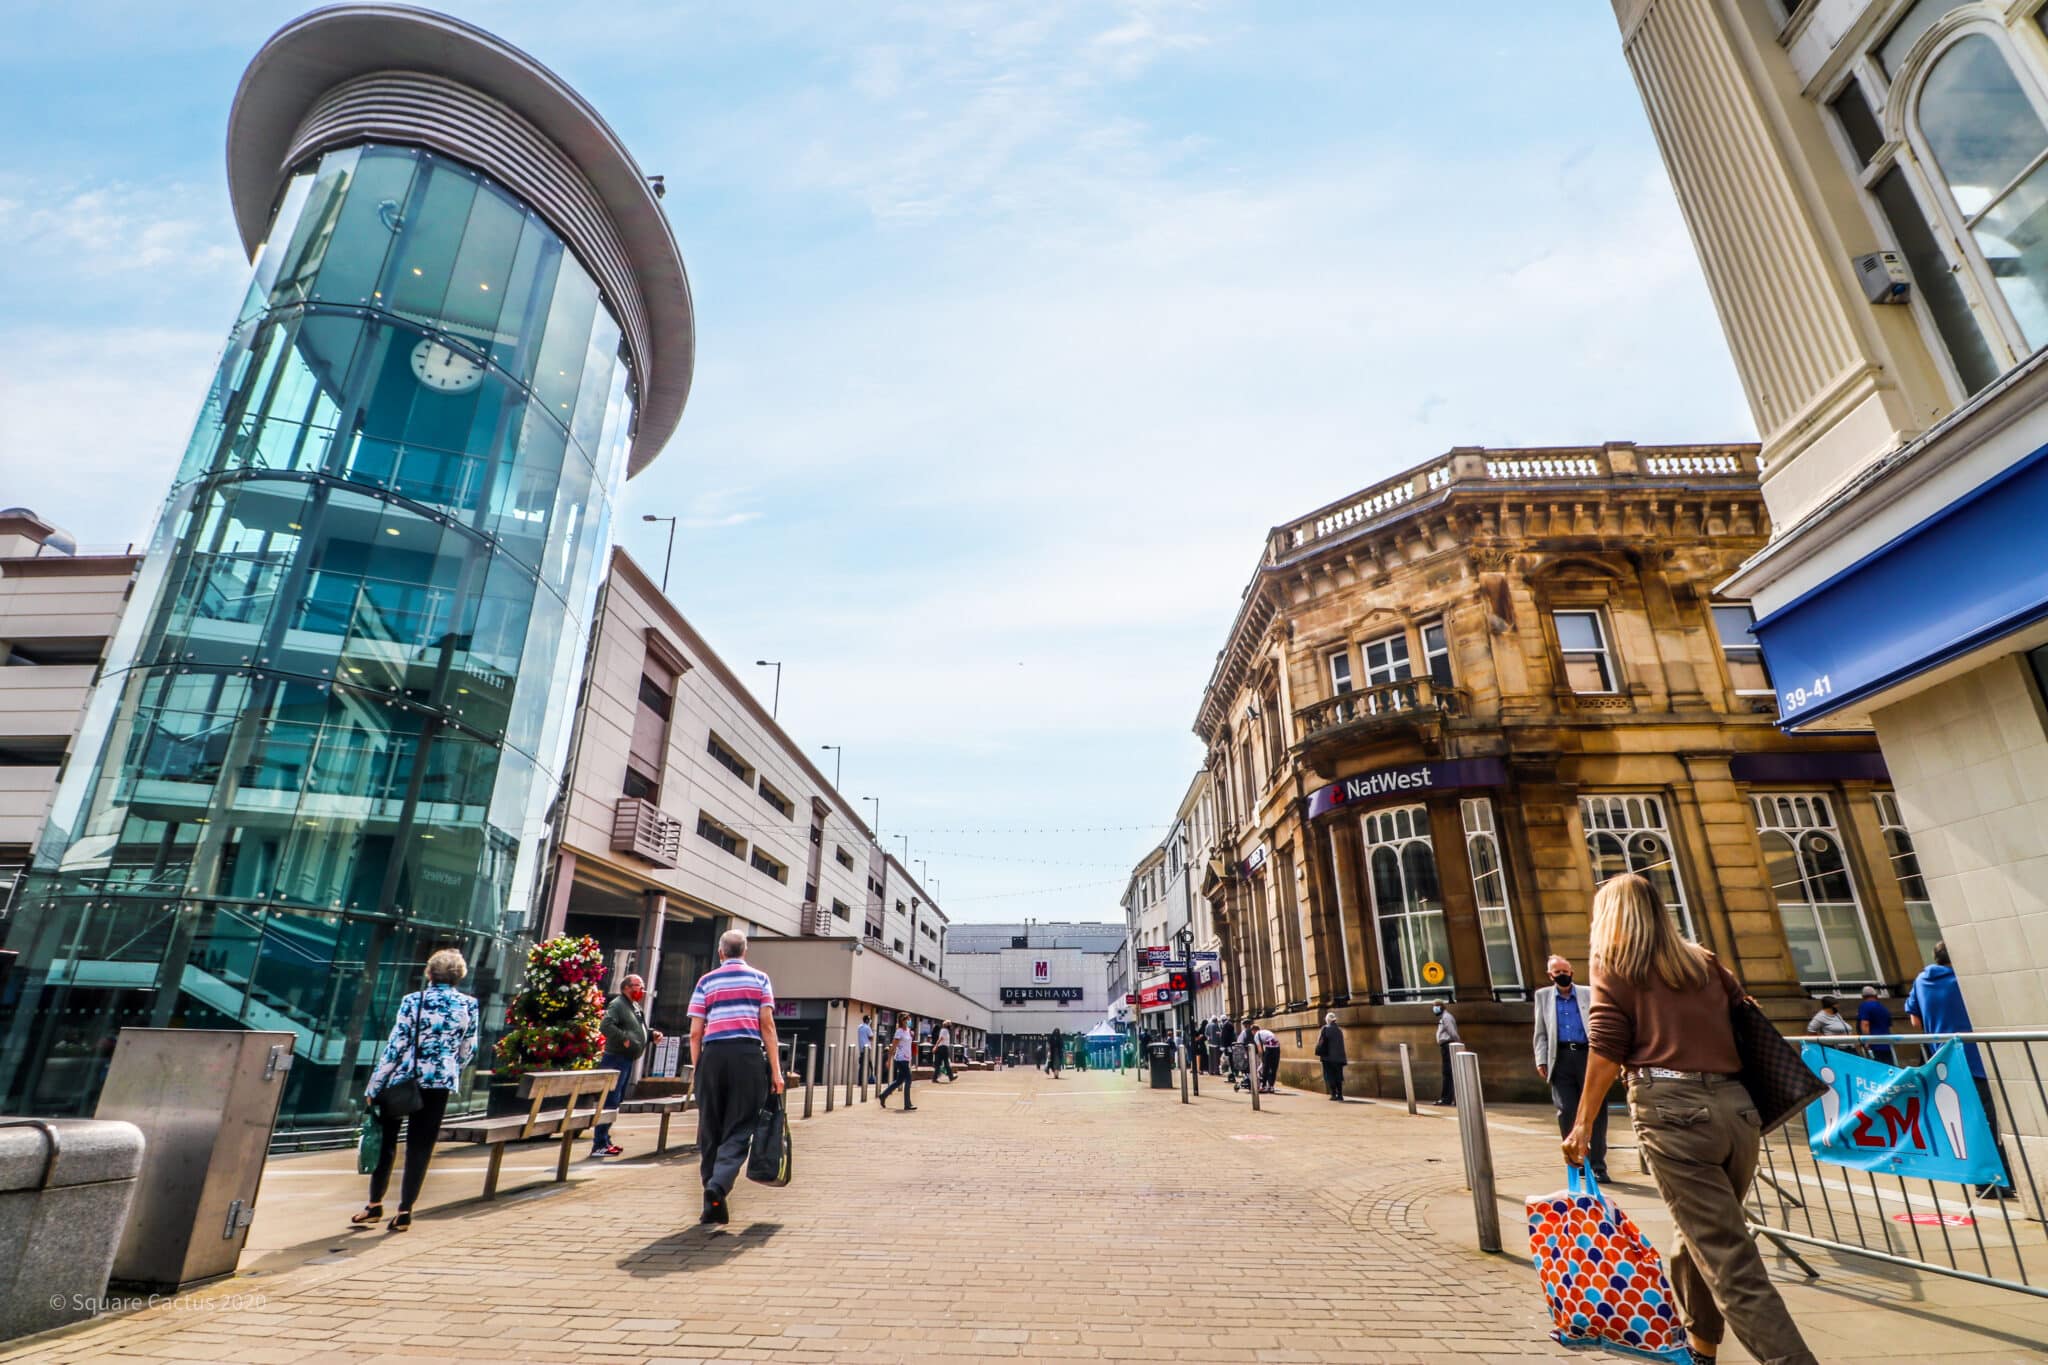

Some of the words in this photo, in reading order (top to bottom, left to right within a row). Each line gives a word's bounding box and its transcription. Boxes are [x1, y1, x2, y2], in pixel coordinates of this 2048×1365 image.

[1785, 674, 1832, 711] 39-41
[1346, 767, 1433, 800] NatWest
[1035, 961, 1048, 977] M
[1006, 989, 1078, 998] DEBENHAMS
[773, 1001, 797, 1017] ME
